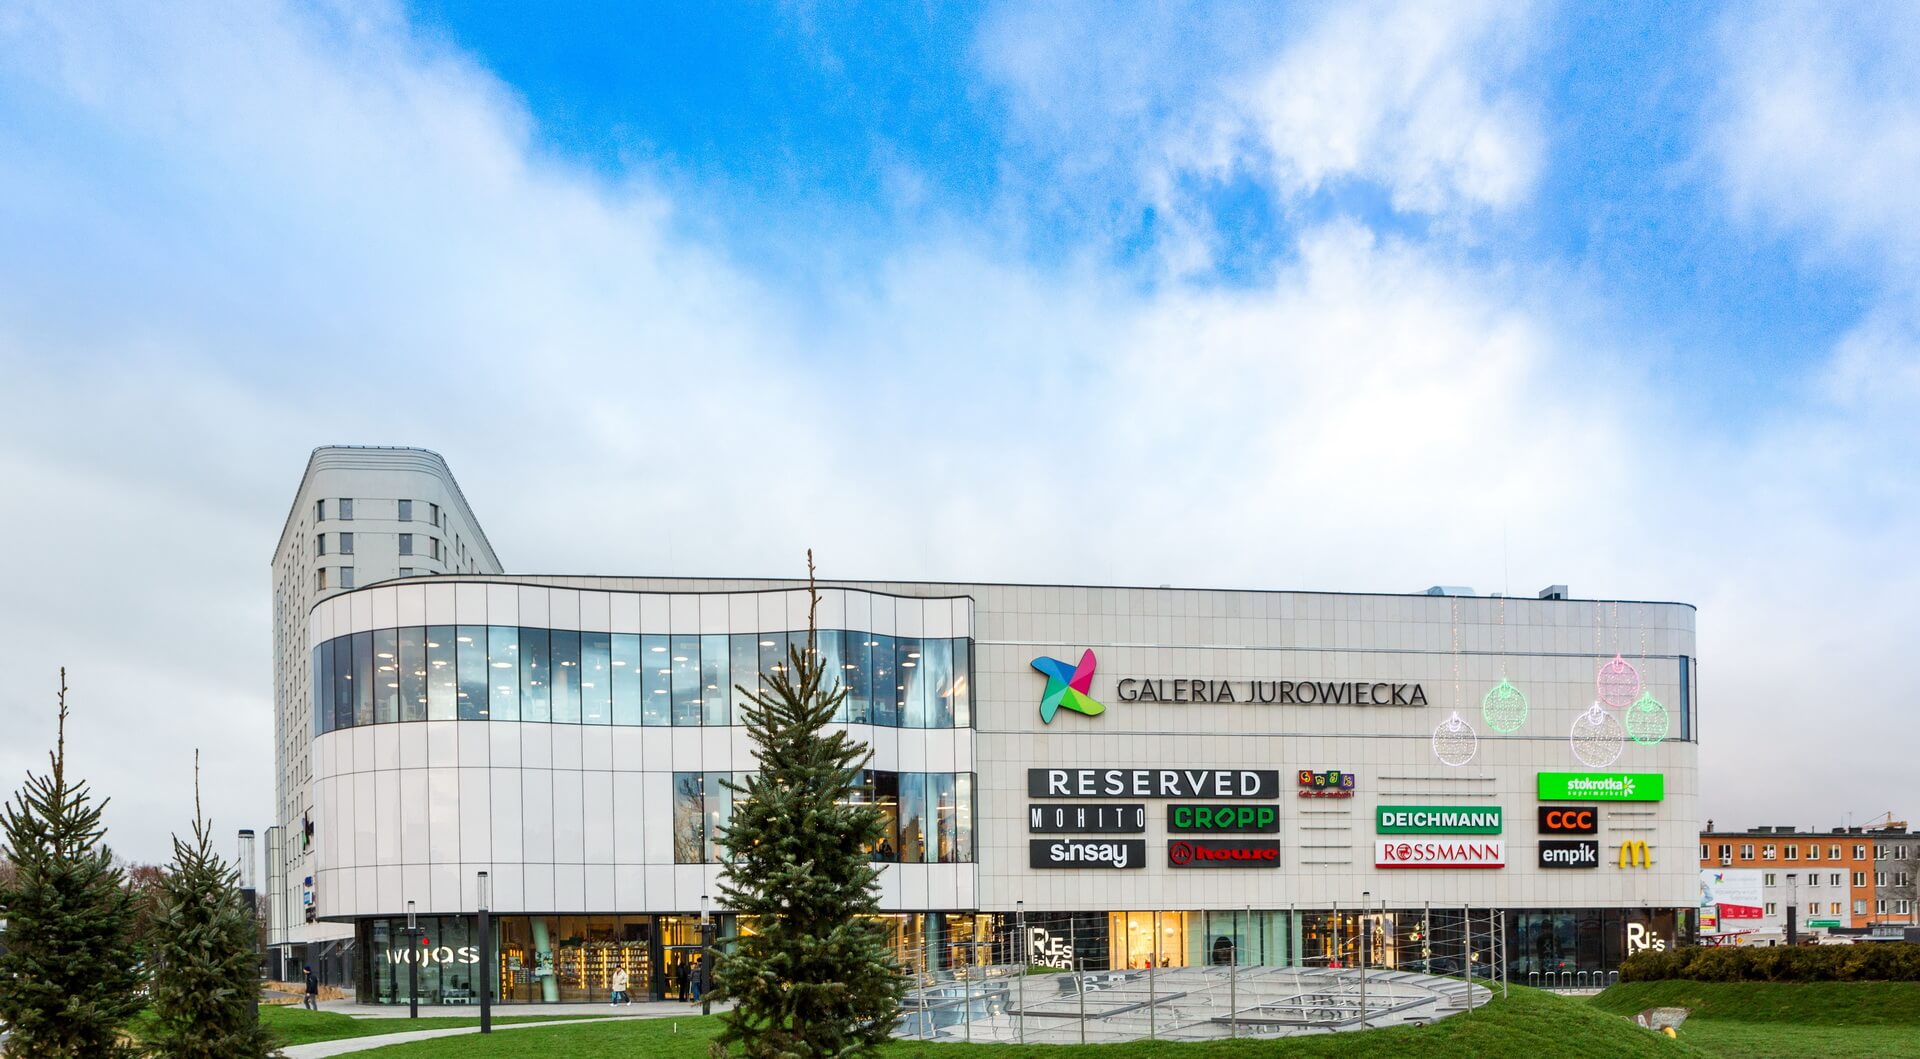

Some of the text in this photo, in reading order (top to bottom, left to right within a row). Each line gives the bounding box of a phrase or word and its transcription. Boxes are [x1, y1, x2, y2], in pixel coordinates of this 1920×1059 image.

[1117, 678, 1428, 706] GALERIA JUROWIECKA
[1048, 769, 1261, 796] RESERVED
[1567, 777, 1623, 790] stokrotka
[1032, 807, 1145, 829] MOHITO
[1174, 806, 1275, 829] CROPP
[1382, 812, 1499, 828] DEICHMANN
[1546, 811, 1592, 829] CCC
[1050, 839, 1128, 868] sinsay
[1195, 846, 1279, 862] house
[1384, 843, 1499, 861] ROSSMANN
[1543, 843, 1596, 865] empik
[386, 937, 480, 968] wojas
